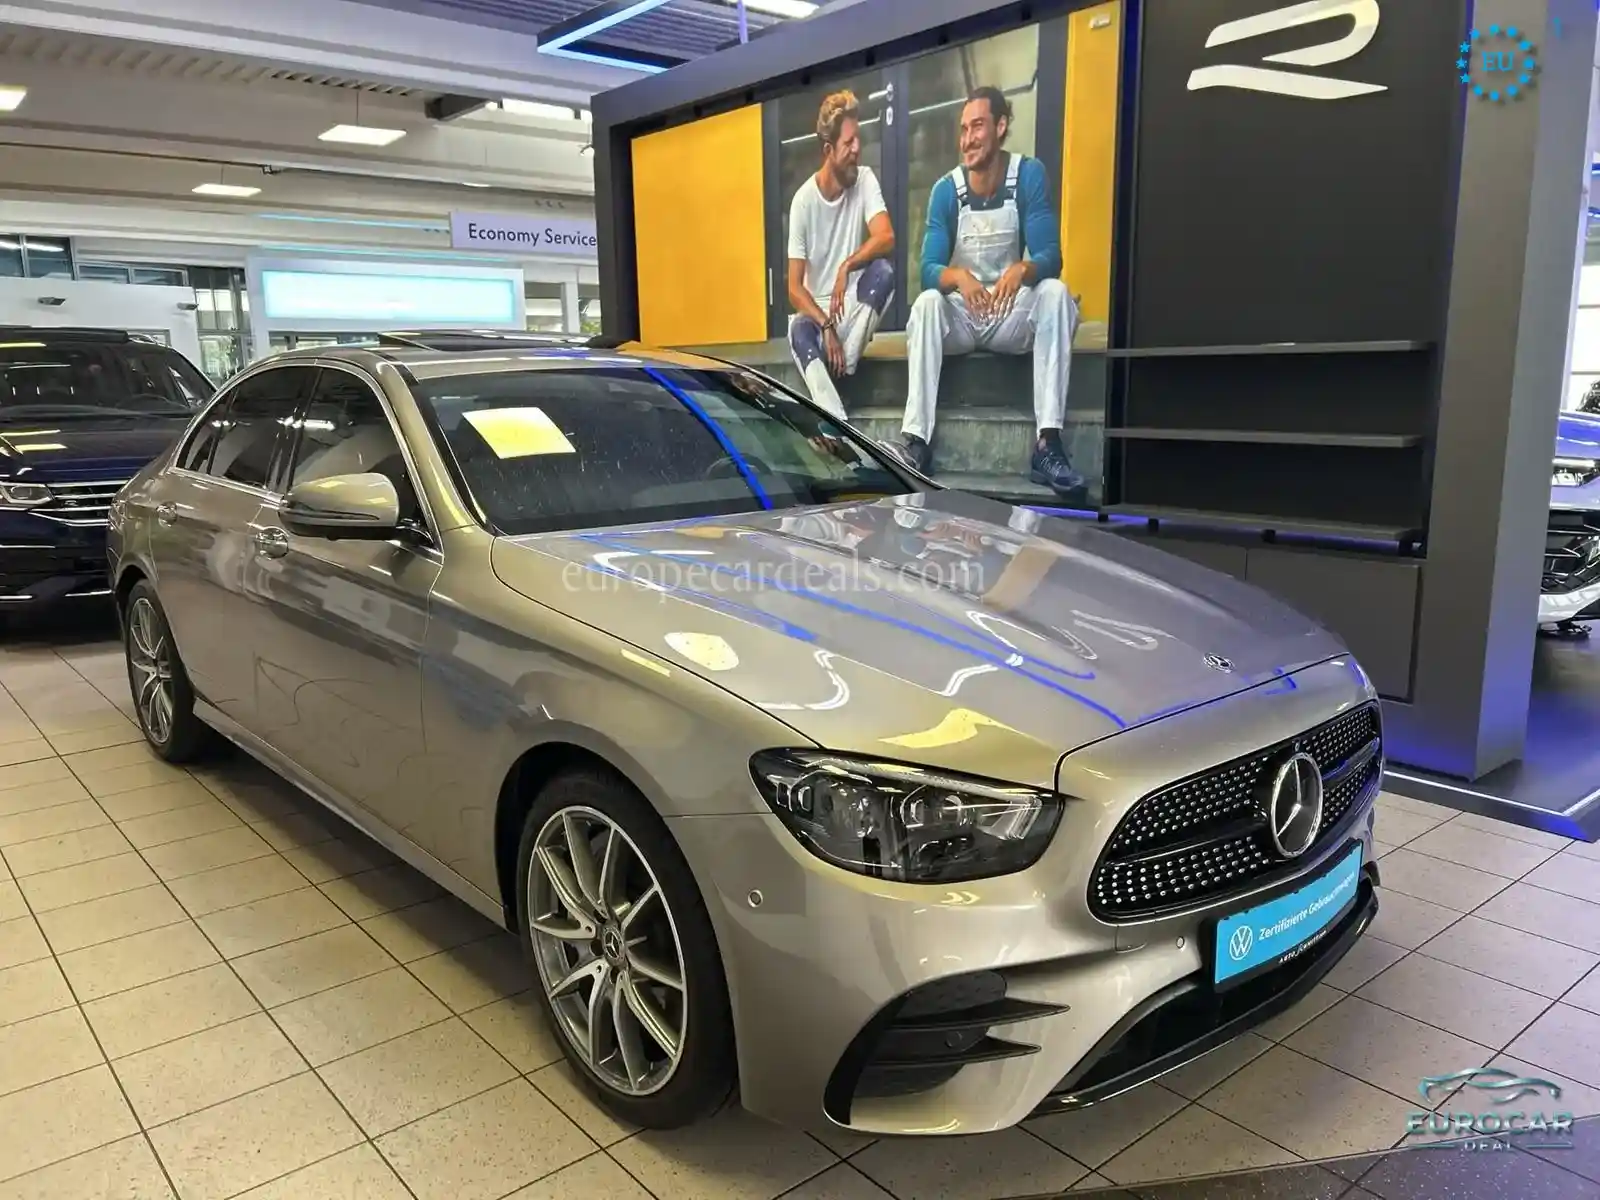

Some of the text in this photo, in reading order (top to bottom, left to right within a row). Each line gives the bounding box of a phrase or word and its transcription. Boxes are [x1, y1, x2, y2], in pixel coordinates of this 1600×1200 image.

[468, 222, 597, 247] Economy Service
[1258, 909, 1308, 941] Zertifizierte
